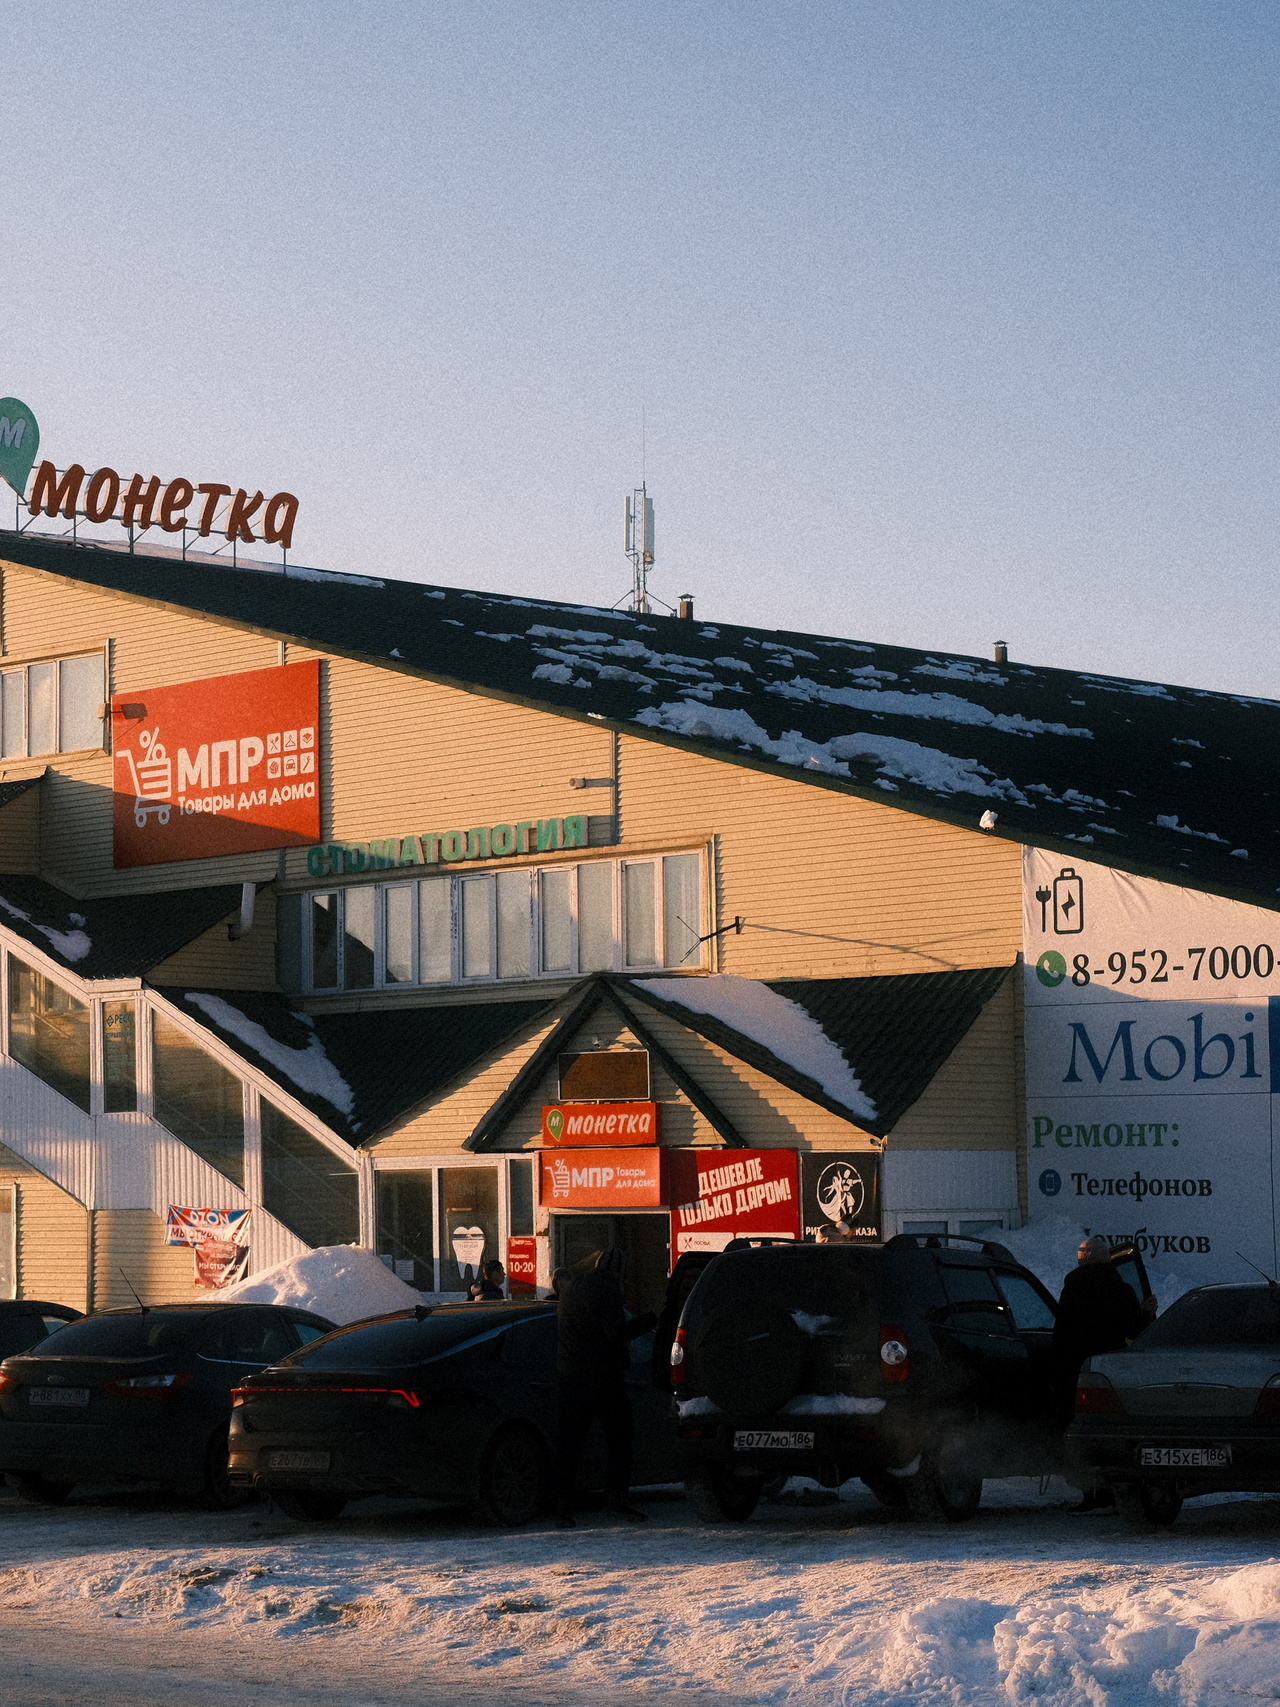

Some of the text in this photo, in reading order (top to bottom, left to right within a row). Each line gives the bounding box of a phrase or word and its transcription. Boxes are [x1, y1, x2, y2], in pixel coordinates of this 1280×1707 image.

[177, 735, 264, 793] МПР
[177, 781, 316, 816] Товары для дома
[307, 814, 589, 878] СТОМАТОЛОГИЯ
[1071, 943, 1280, 988] 8-952-7000
[1061, 1011, 1263, 1085] Mobi
[1031, 1115, 1180, 1149] Ремонт:
[571, 1166, 615, 1188] МПР
[615, 1166, 647, 1179] Товары
[615, 1178, 657, 1189] для дома
[697, 1157, 765, 1198] ДЕШЕВЛЕ
[1071, 1170, 1214, 1202] Телефонов
[677, 1177, 793, 1228] ТОЛЬКО ДАРОМ!
[854, 1226, 878, 1237] КАЗА
[1085, 1227, 1211, 1258] убуков
[790, 1433, 812, 1445] 186
[1202, 1448, 1226, 1462] 186
